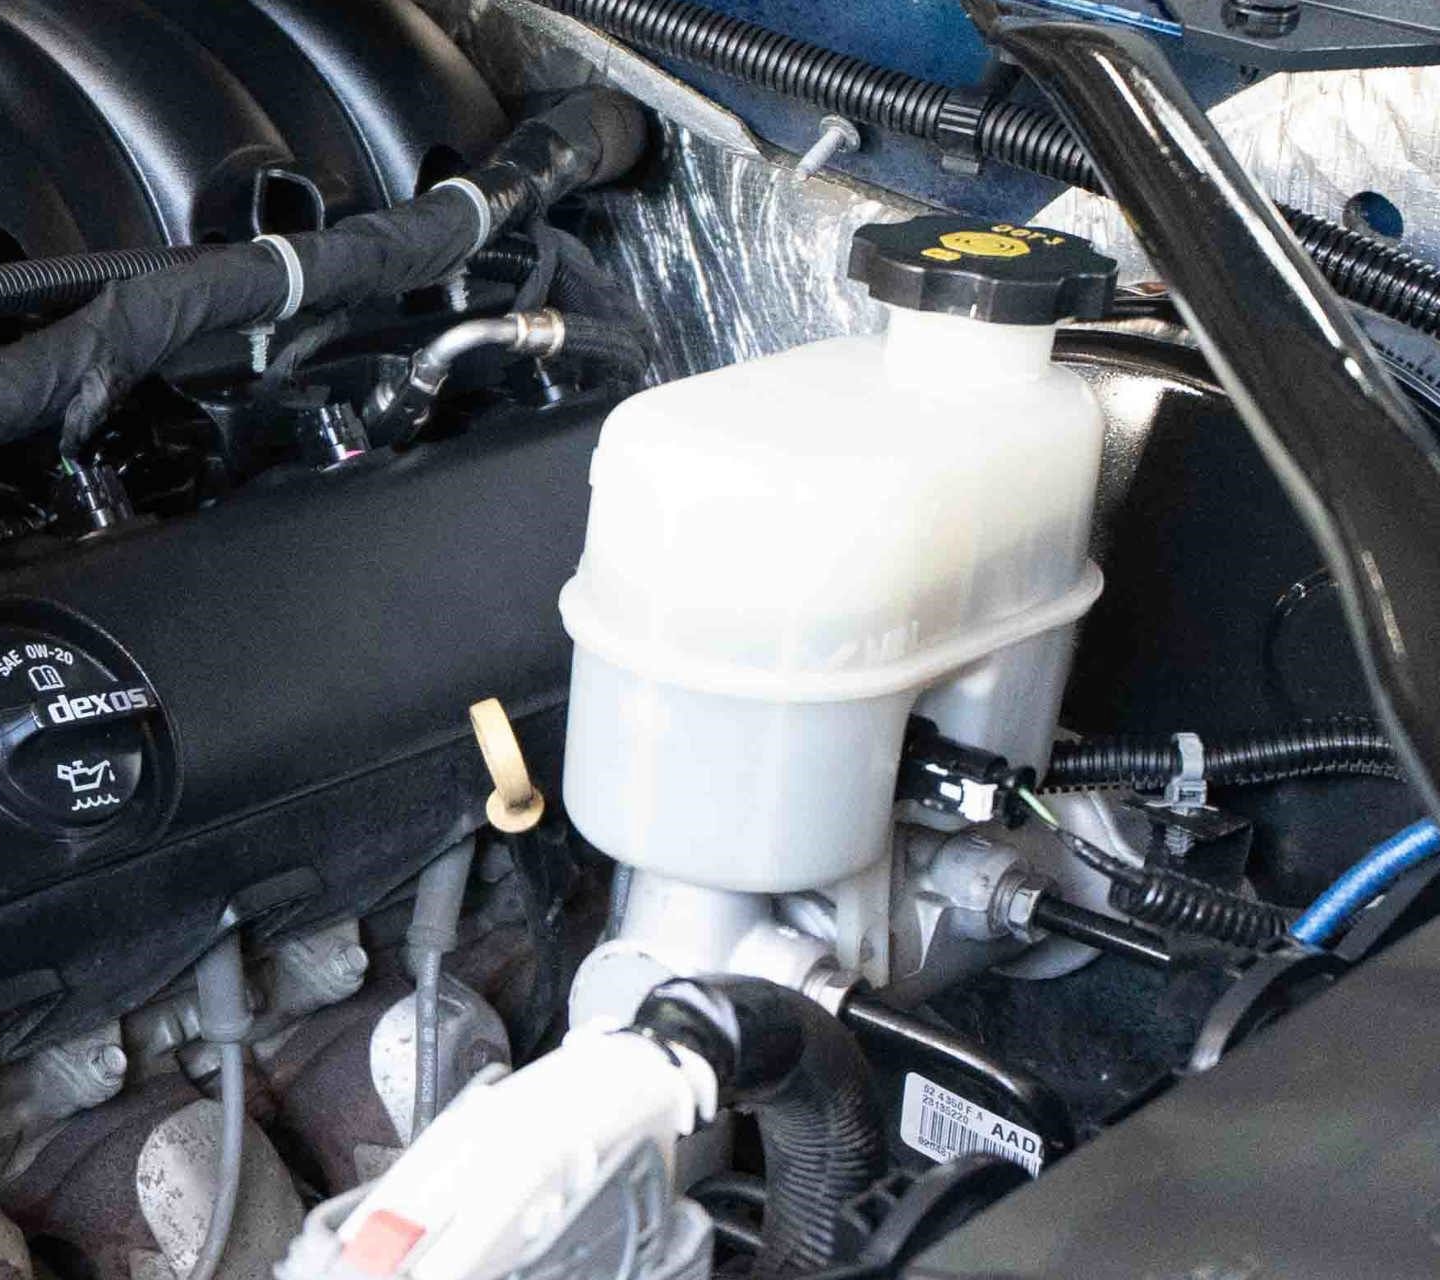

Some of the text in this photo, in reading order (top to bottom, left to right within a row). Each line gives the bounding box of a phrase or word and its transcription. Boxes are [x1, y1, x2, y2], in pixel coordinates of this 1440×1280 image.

[25, 644, 74, 666] 0W-20
[48, 689, 149, 724] dexos
[992, 1124, 1036, 1154] AAD
